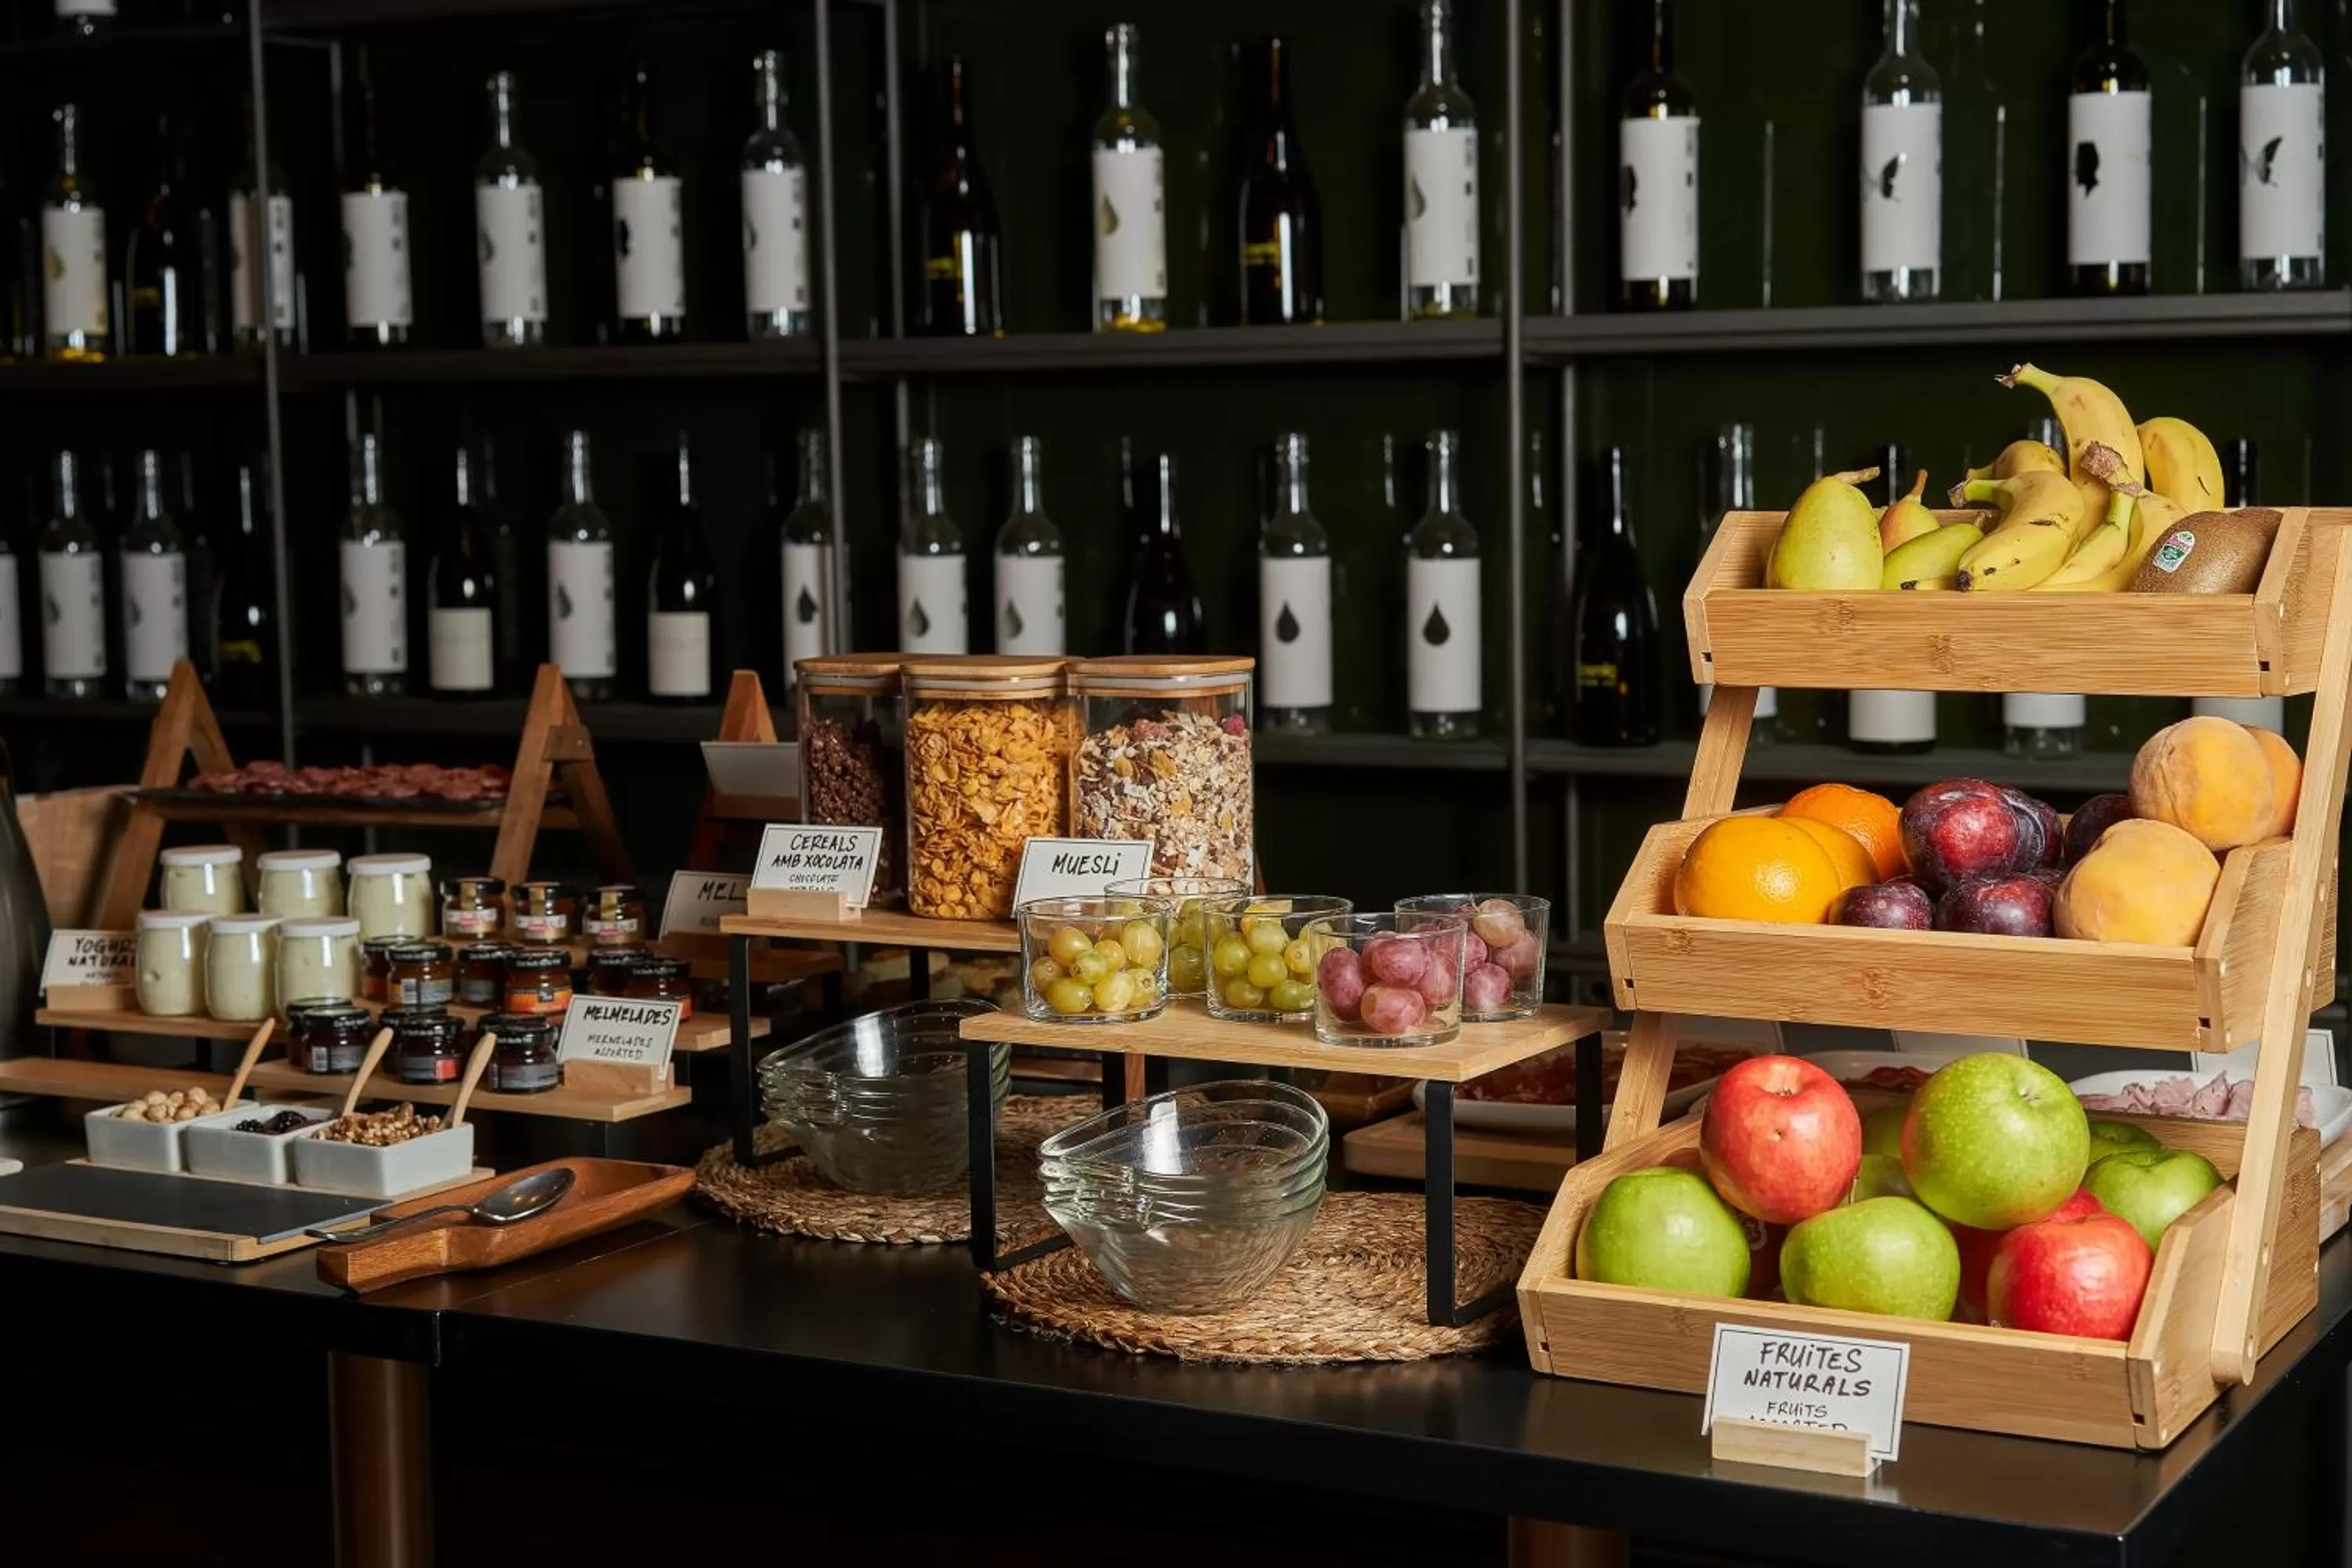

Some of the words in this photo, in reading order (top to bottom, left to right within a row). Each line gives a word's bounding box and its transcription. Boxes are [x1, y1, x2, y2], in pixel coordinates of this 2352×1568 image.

[789, 833, 858, 853] CEREALS
[771, 854, 800, 868] AMB
[802, 855, 864, 871] XOCOLATA
[789, 873, 840, 884] CHOCOLATE
[583, 1004, 673, 1026] MELMELADES
[1743, 1368, 1872, 1397] NATURALS
